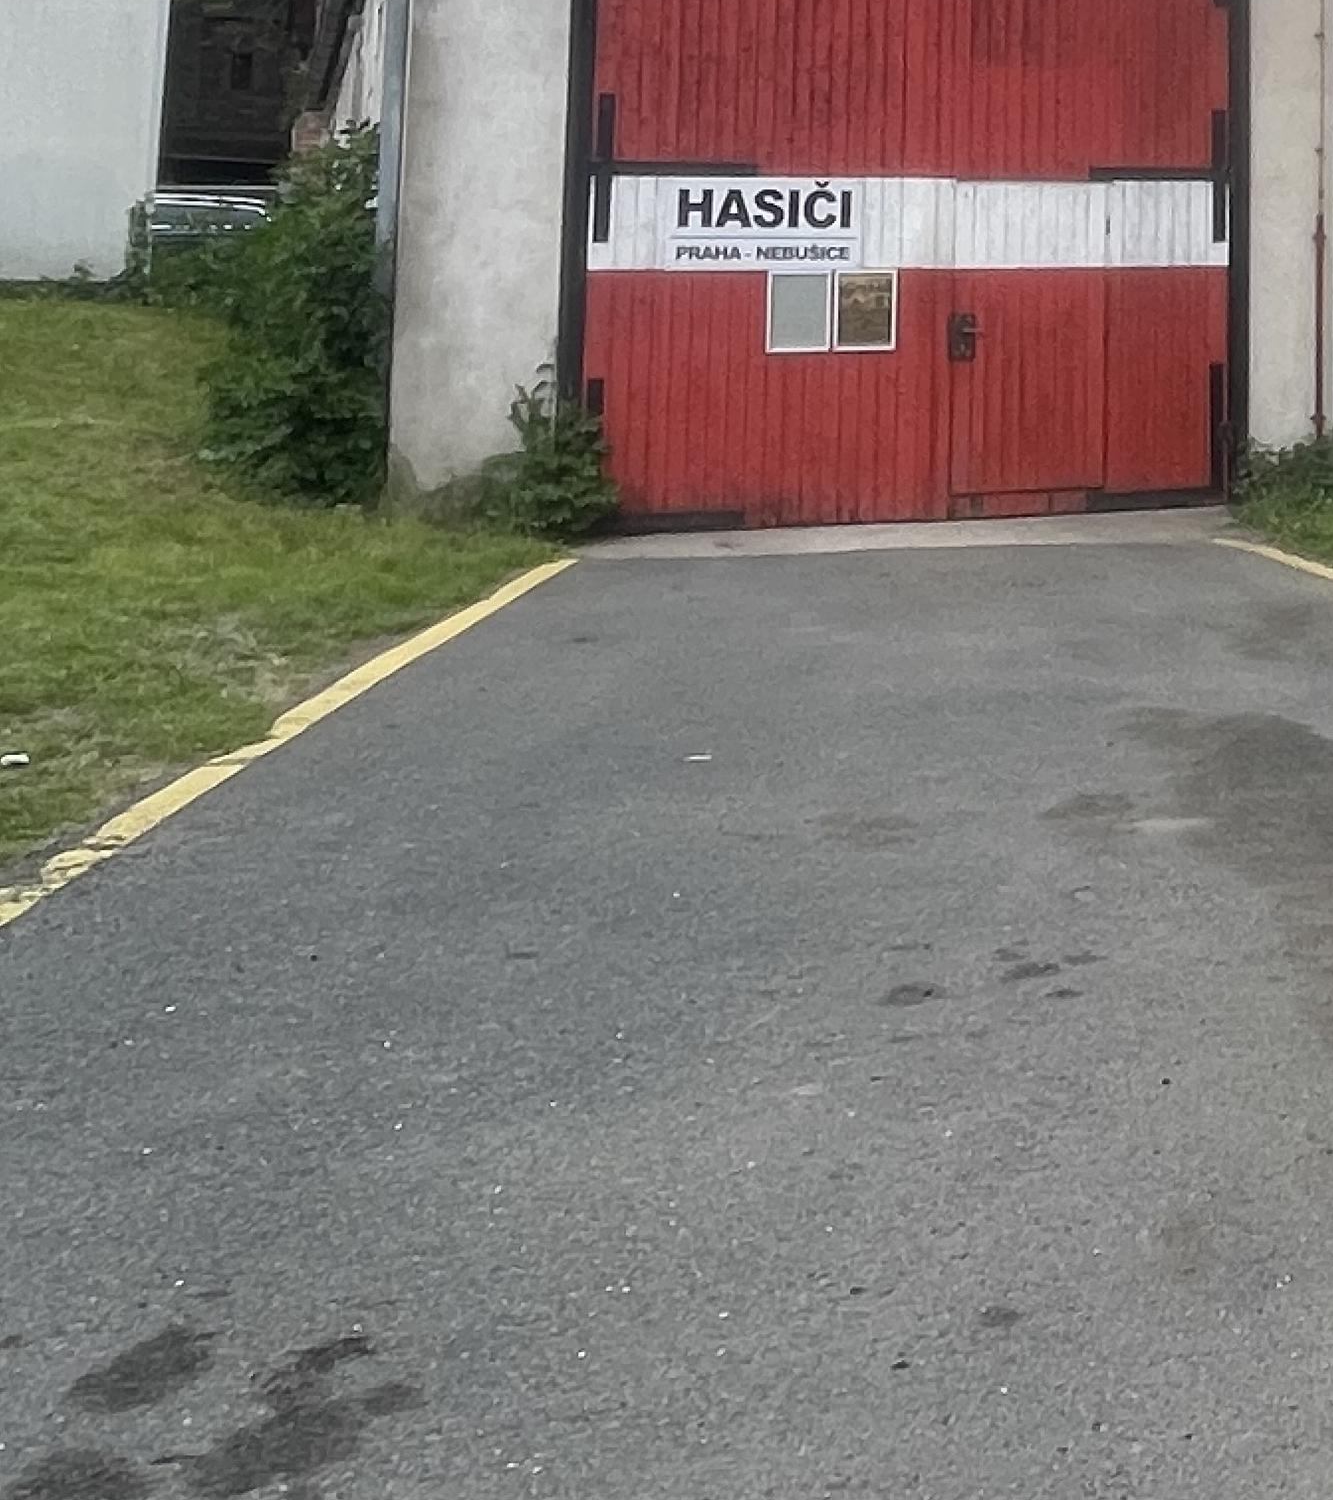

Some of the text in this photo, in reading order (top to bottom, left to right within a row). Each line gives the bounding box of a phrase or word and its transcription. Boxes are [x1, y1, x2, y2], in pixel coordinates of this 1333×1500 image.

[675, 180, 853, 228] HASIČI
[675, 245, 742, 261] PRAHA
[755, 242, 850, 262] NEBUŠICE
